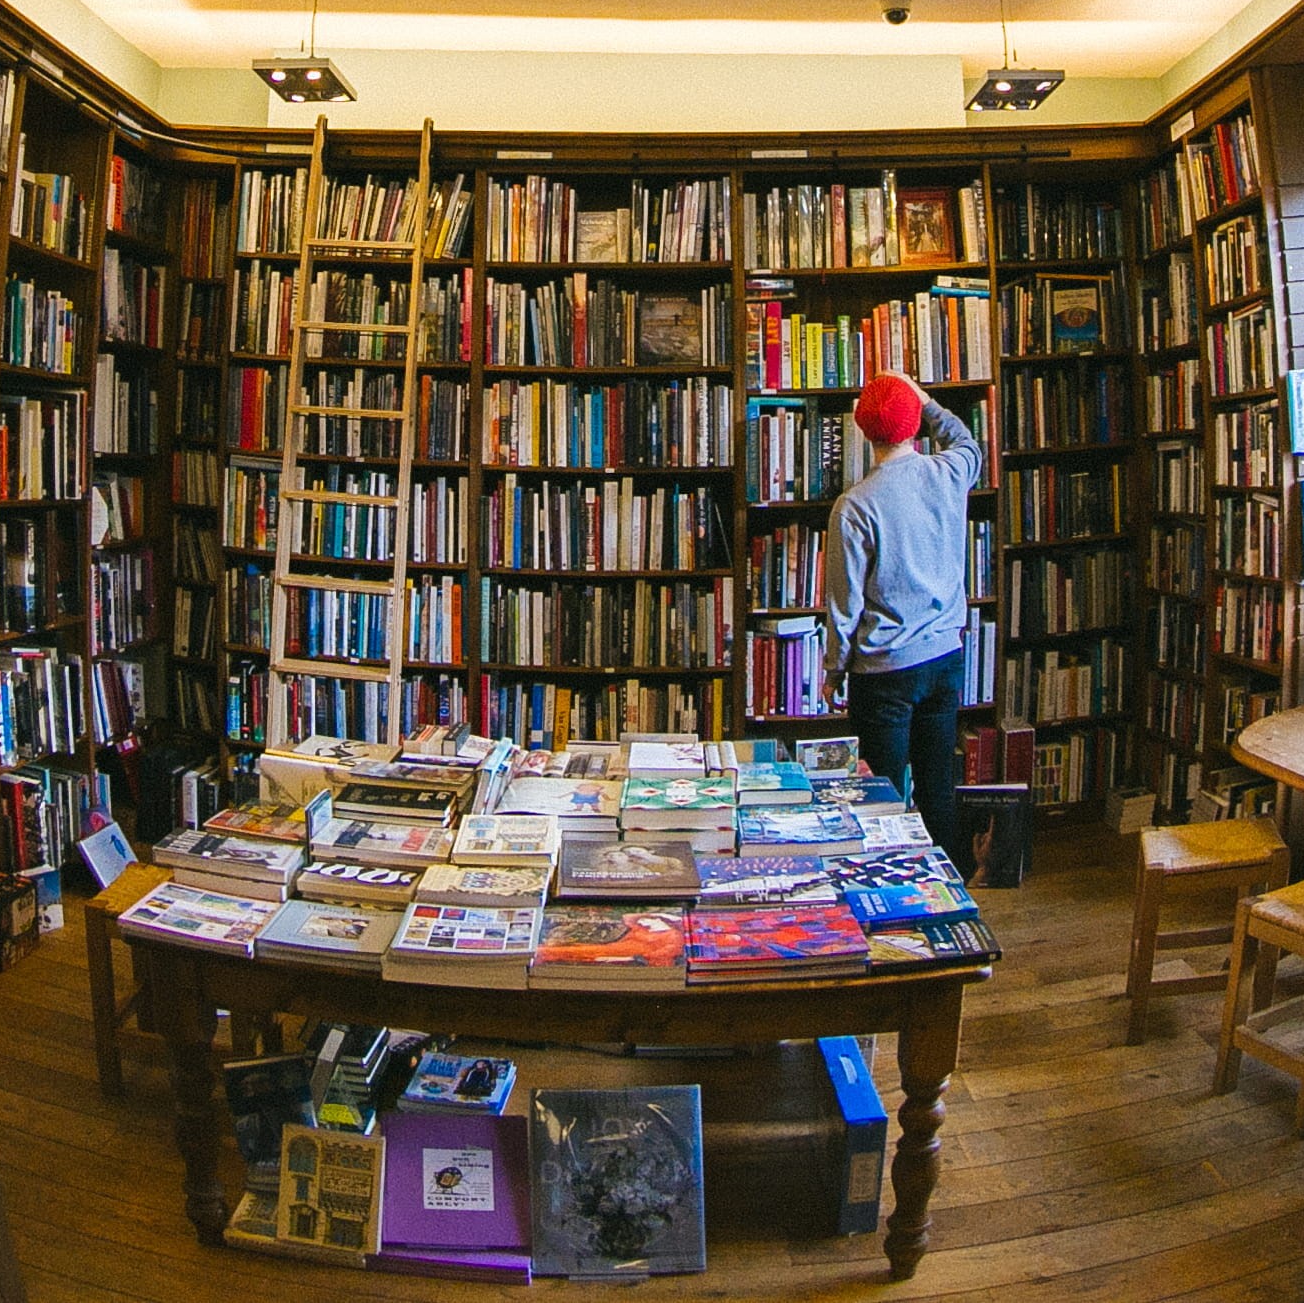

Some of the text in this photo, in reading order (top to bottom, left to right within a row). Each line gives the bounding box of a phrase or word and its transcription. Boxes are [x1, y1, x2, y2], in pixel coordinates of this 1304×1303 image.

[766, 315, 781, 345] art
[822, 416, 831, 470] ANIMAL
[832, 416, 842, 462] PLANT
